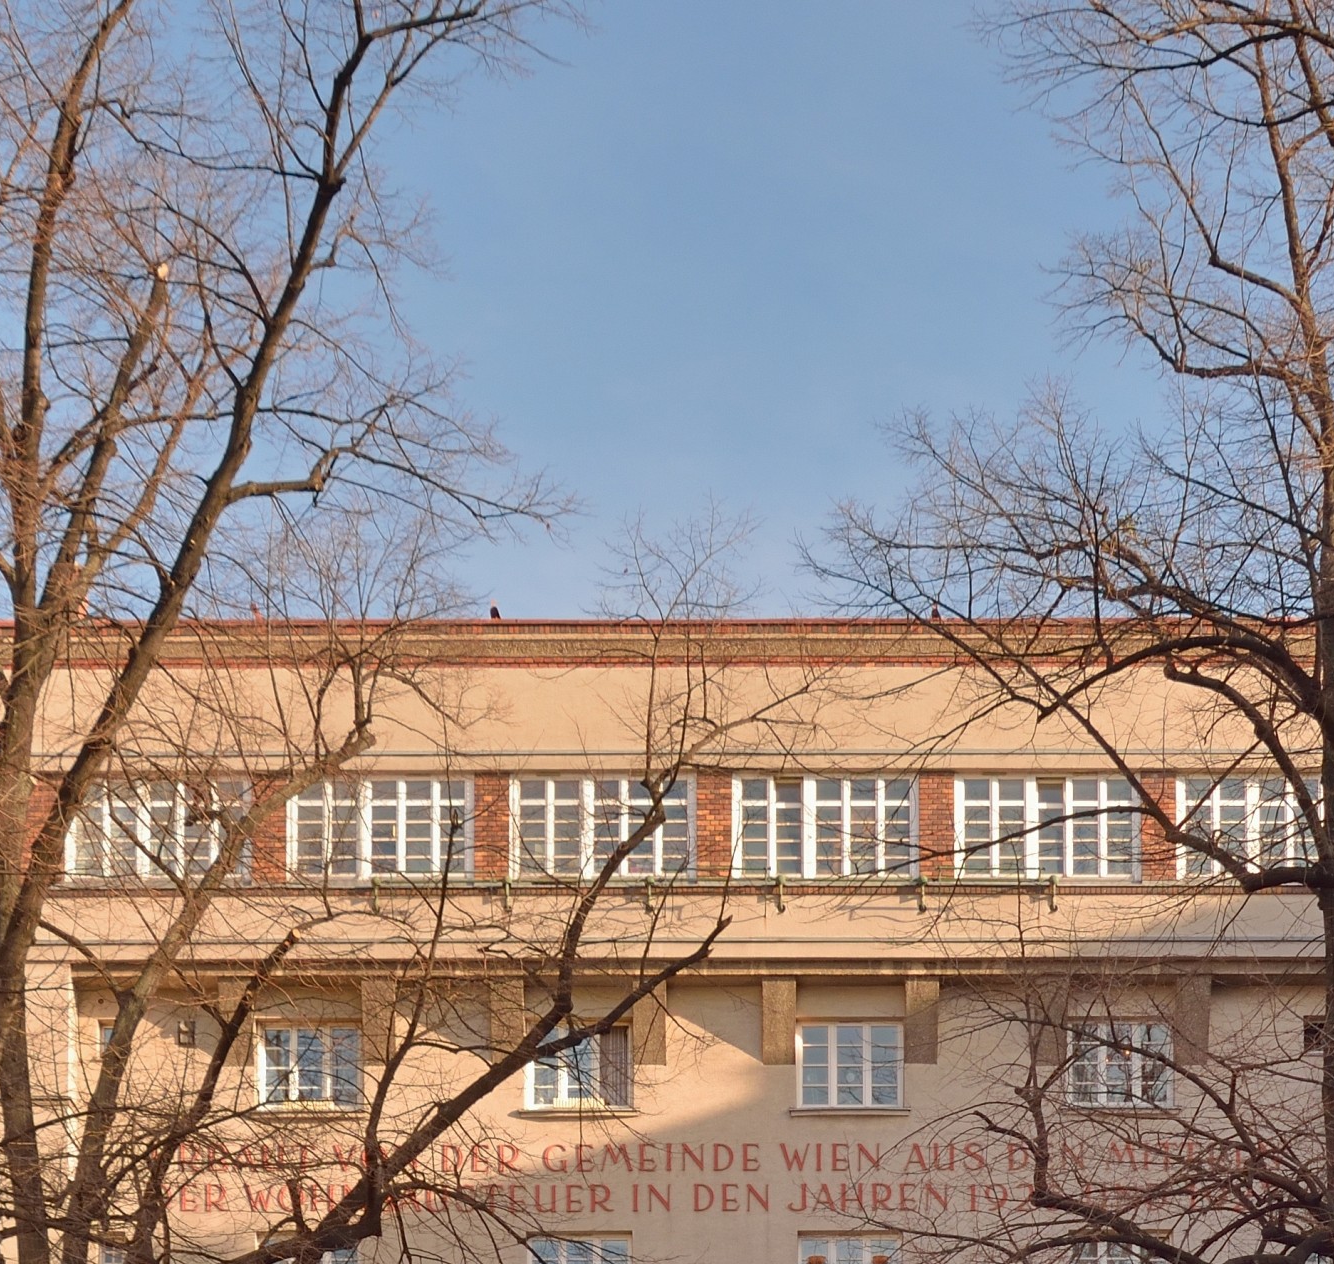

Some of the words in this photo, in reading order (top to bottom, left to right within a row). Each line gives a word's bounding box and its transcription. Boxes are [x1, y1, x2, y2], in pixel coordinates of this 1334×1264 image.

[149, 1142, 317, 1172] RBAUT
[441, 1143, 524, 1174] DER
[542, 1142, 760, 1173] GEMEINDE
[779, 1142, 883, 1172] WIEN
[905, 1141, 987, 1172] AUS
[1007, 1143, 1086, 1172] DN
[632, 1184, 674, 1213] IN
[693, 1184, 771, 1213] DEN
[787, 1183, 950, 1214] JAHREN
[969, 1184, 1058, 1214] 192
